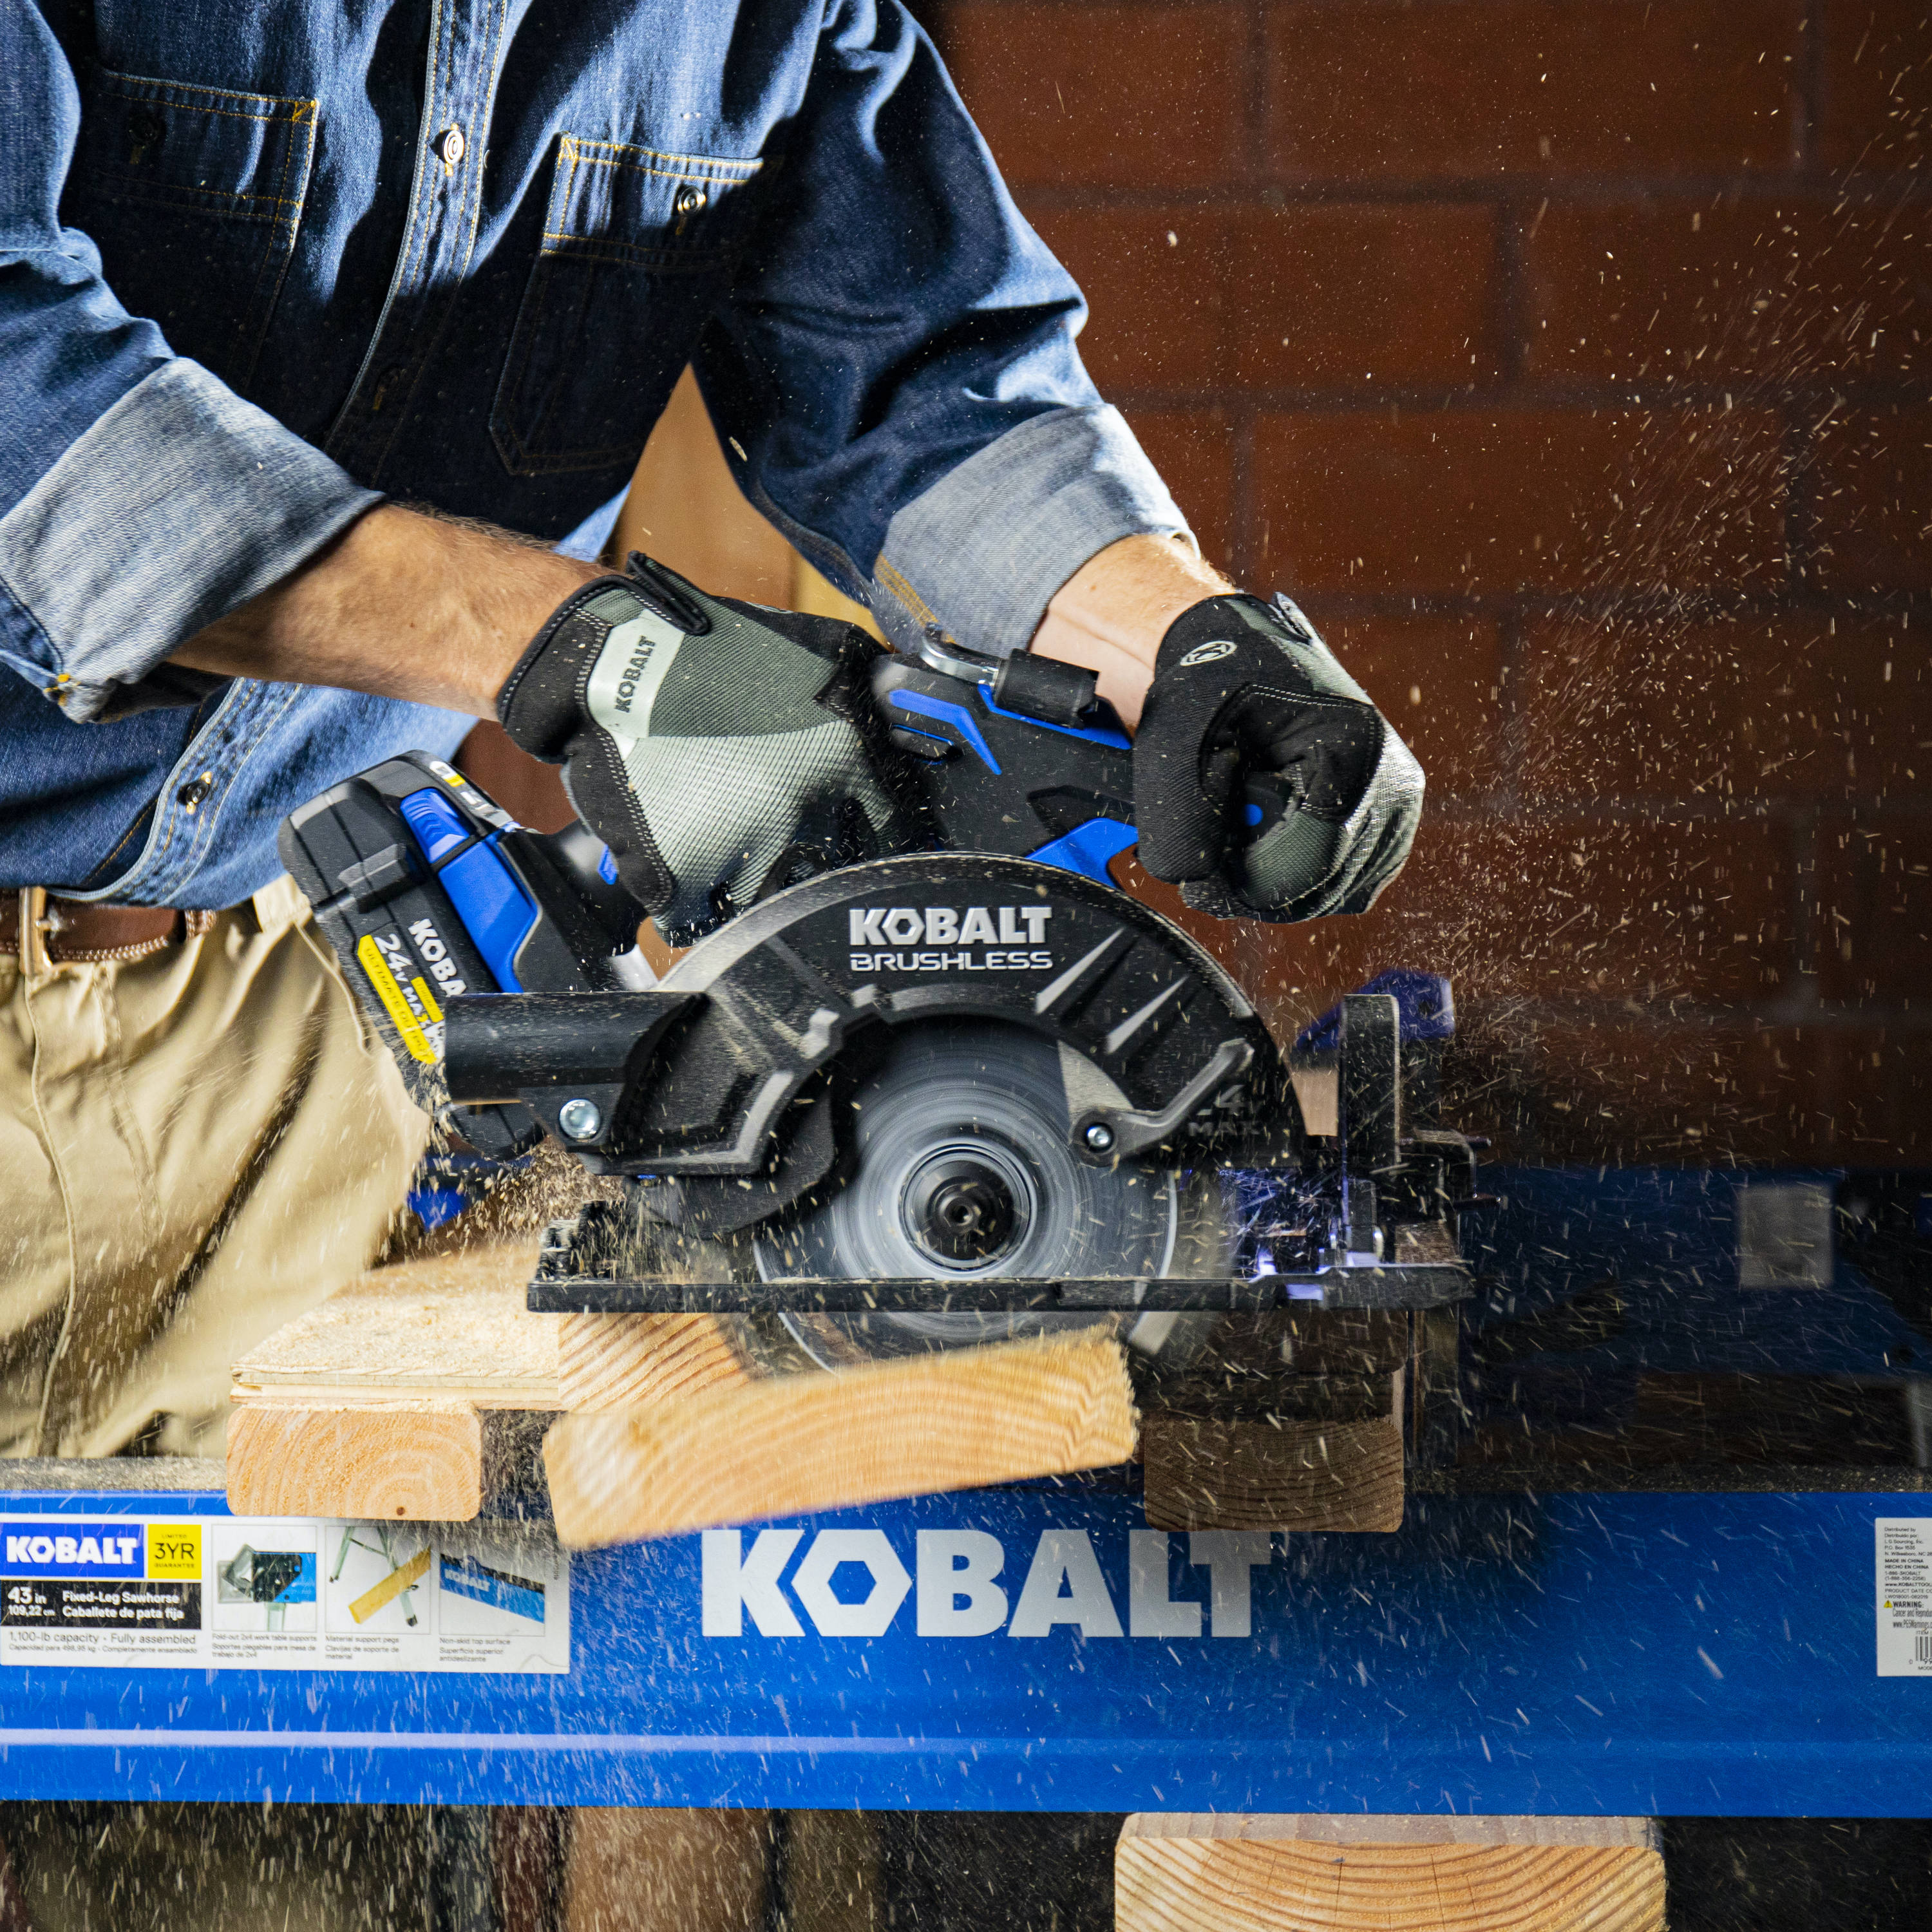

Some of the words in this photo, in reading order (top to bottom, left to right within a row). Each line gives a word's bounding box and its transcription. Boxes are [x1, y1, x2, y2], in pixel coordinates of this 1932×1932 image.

[614, 635, 656, 713] KOBALT
[848, 906, 1052, 946] KOBALT
[408, 918, 467, 997] KOBA
[849, 951, 1052, 972] BRUSHLESS
[6, 1536, 137, 1564] KOBALT
[155, 1542, 194, 1559] 3YR
[444, 1569, 490, 1592] KOBALT
[701, 1529, 1273, 1638] KOBALT
[8, 1586, 33, 1604] 43
[35, 1592, 47, 1604] in
[62, 1590, 120, 1605] Fixed-Leg
[122, 1591, 180, 1604] Sawhorse
[8, 1605, 43, 1617] 109,22
[62, 1605, 117, 1618] Caballete
[119, 1607, 135, 1618] de
[136, 1609, 163, 1620] pata
[165, 1607, 185, 1622] fija
[54, 1633, 99, 1644] capacity
[111, 1633, 137, 1645] Fully
[139, 1634, 196, 1644] assembled
